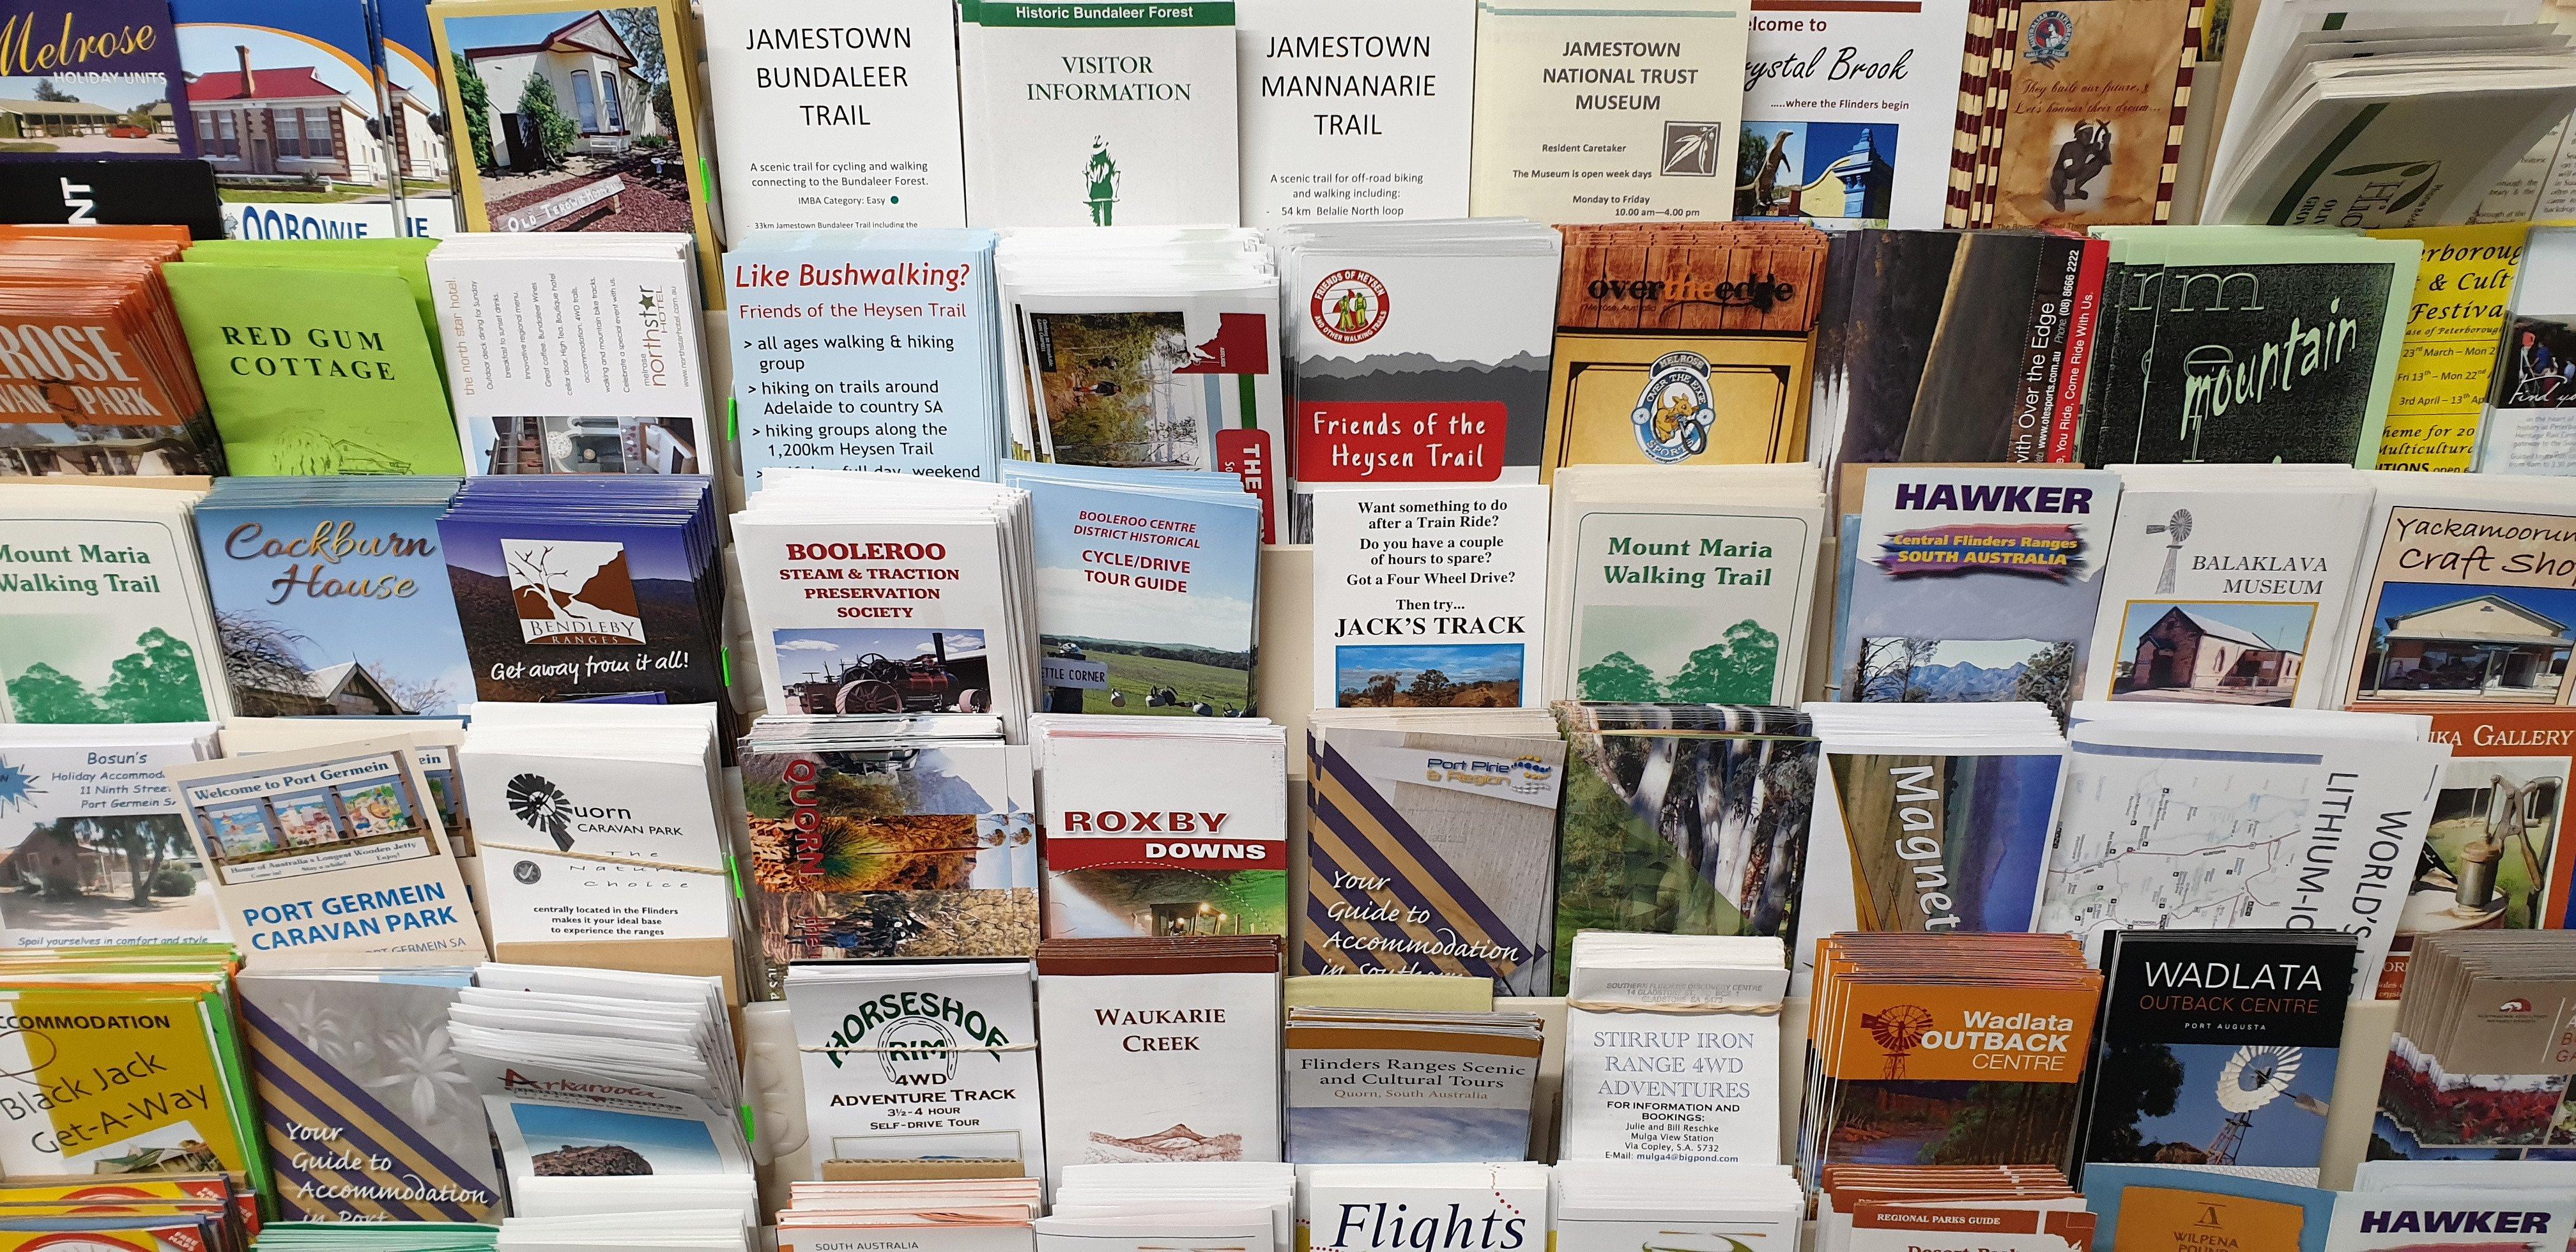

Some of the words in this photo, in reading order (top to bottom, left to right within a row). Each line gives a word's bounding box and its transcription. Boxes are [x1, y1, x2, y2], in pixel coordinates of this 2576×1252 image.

[1016, 6, 1070, 19] Historic
[1074, 6, 1144, 19] Bundaleer
[1149, 6, 1193, 19] Forest
[746, 27, 911, 50] JAMESTOWN
[1266, 36, 1430, 58] JAMESTOWN
[1563, 42, 1680, 57] JAMESTOWN
[1061, 56, 1153, 74] VISITOR
[53, 72, 122, 84] HOLIDAY
[125, 72, 166, 84] UNITS
[757, 66, 908, 88] BUNDALEER
[1262, 75, 1436, 97] MANNANARIE
[1543, 68, 1634, 84] NATIONAL
[1641, 69, 1698, 84] TRUST
[1027, 83, 1191, 102] INFORMATION
[1575, 95, 1660, 111] MUSEUM
[800, 105, 870, 125] TRAIL
[1314, 114, 1382, 135] TRAIL
[760, 162, 790, 171] scenic
[792, 162, 813, 171] trail
[815, 162, 830, 171] for
[833, 162, 866, 174] cycling
[869, 161, 887, 171] and
[890, 161, 928, 173] walking
[1513, 170, 1529, 178] The
[1531, 170, 1569, 178] Museum
[1572, 170, 1578, 178] is
[1581, 171, 1602, 180] open
[1606, 169, 1628, 178] week
[1630, 170, 1652, 180] days
[2067, 250, 2079, 272] 2222
[735, 264, 789, 287] Like
[799, 263, 969, 291] Bushwalking?
[2062, 273, 2074, 297] 8666
[740, 303, 801, 319] Friends
[808, 303, 824, 317] of
[831, 304, 857, 317] the
[864, 303, 922, 319] Heysen
[928, 303, 967, 317] Trail
[2060, 300, 2071, 316] (08)
[2032, 303, 2056, 350] Edge
[220, 326, 291, 346] RED
[308, 328, 385, 351] GUM
[230, 356, 395, 380] COTTAGE
[2027, 355, 2044, 385] the
[2181, 296, 2357, 441] mountain
[2018, 388, 2039, 429] Over
[2399, 397, 2415, 405] 3rd
[2417, 396, 2439, 404] April
[1314, 411, 1401, 436] Friends
[1413, 413, 1438, 435] of
[1449, 413, 1485, 434] the
[1332, 444, 1413, 476] Heysen
[1426, 444, 1483, 467] Trail
[1895, 484, 2093, 514] HAWKER
[1079, 511, 1147, 527] BOOLEROO
[1150, 520, 1196, 533] CENTRE
[225, 520, 436, 563] Cockburn
[786, 543, 946, 560] BOOLEROO
[1608, 537, 1690, 556] Mount
[1699, 539, 1772, 558] Maria
[1894, 535, 1949, 546] Central
[1954, 535, 2016, 547] Flinders
[2020, 537, 2077, 549] Ranges
[1082, 550, 1190, 574] CYCLE/DRIVE
[1897, 551, 1958, 562] SOUTH
[1965, 553, 2066, 565] AUSTRALIA
[2192, 556, 2327, 572] BALAKLAVA
[2400, 546, 2495, 579] Craft
[266, 563, 418, 605] House
[780, 569, 844, 580] STEAM
[848, 569, 862, 579] &
[866, 569, 959, 580] TRACTION
[1085, 570, 1130, 586] TOUR
[1135, 577, 1187, 592] GUIDE
[1604, 566, 1706, 588] Walking
[1715, 568, 1772, 586] Trail
[804, 588, 940, 599] PRESERVATION
[2223, 579, 2323, 594] MUSEUM
[837, 607, 913, 618] SOCIETY
[530, 620, 636, 636] BENDLEBY
[1335, 618, 1425, 637] JACK'S
[1434, 616, 1525, 634] TRACK
[552, 636, 618, 644] RANGES
[491, 663, 525, 680] Get
[529, 664, 578, 683] away
[585, 655, 629, 677] from
[636, 653, 652, 671] it
[656, 652, 689, 669] all!
[88, 752, 148, 764] Bosun's
[1427, 758, 1467, 769] Port
[1472, 761, 1510, 774] Pirie
[195, 785, 261, 801] Welcome
[266, 781, 280, 790] to
[284, 772, 317, 786] Port
[319, 761, 389, 780] Germein
[782, 759, 826, 875] QUORN
[1064, 811, 1229, 834] ROXBY
[578, 823, 643, 835] CARAVAN
[649, 826, 683, 836] PARK
[1146, 843, 1266, 860] DOWNS
[1889, 765, 1961, 931] Magnet
[1333, 870, 1390, 890] Your
[243, 901, 312, 927] PORT
[323, 882, 446, 915] GERMEIN
[533, 906, 574, 914] centrally
[1328, 901, 1400, 922] Guide
[1406, 905, 1430, 924] to
[252, 919, 381, 951] CARAVAN
[387, 906, 458, 932] PARK
[1323, 928, 1519, 961] Accommodation
[2145, 961, 2322, 991] WADLATA
[2140, 995, 2234, 1011] OUTBACK
[2241, 998, 2319, 1014] CENTRE
[1094, 1009, 1225, 1026] WAUKARIE
[1964, 1011, 2073, 1032] Wadlata
[1123, 1035, 1200, 1051] CREEK
[1593, 1032, 1690, 1048] STIRRUP
[1698, 1032, 1755, 1049] IRON
[1921, 1031, 2071, 1053] OUTBACK
[1301, 1058, 1380, 1070] Flinders
[1388, 1059, 1456, 1073] Ranges
[1462, 1062, 1525, 1075] Scenic
[1605, 1057, 1685, 1073] RANGE
[1692, 1058, 1744, 1073] 4WD
[1973, 1054, 2065, 1071] CENTRE
[0, 1076, 91, 1121] Black
[93, 1051, 167, 1091] Jack
[894, 1073, 947, 1085] 4WD
[1320, 1074, 1354, 1085] and
[1362, 1074, 1441, 1086] Cultural
[1448, 1076, 1504, 1088] Tours
[1597, 1080, 1750, 1098] ADVENTURES
[831, 1092, 947, 1106] ADVENTURE
[951, 1088, 1016, 1101] TRACK
[31, 1084, 210, 1154] Get-A-Way
[1605, 1151, 1634, 1160] E-Mail:
[1636, 1153, 1738, 1163] mulga4@bigpond.com
[1330, 1203, 1526, 1252] Flights
[1877, 1214, 1929, 1223] REGIONAL
[1932, 1216, 1965, 1224] PARKS
[1968, 1216, 2000, 1225] GUIDE
[2360, 1210, 2551, 1233] HAWKER
